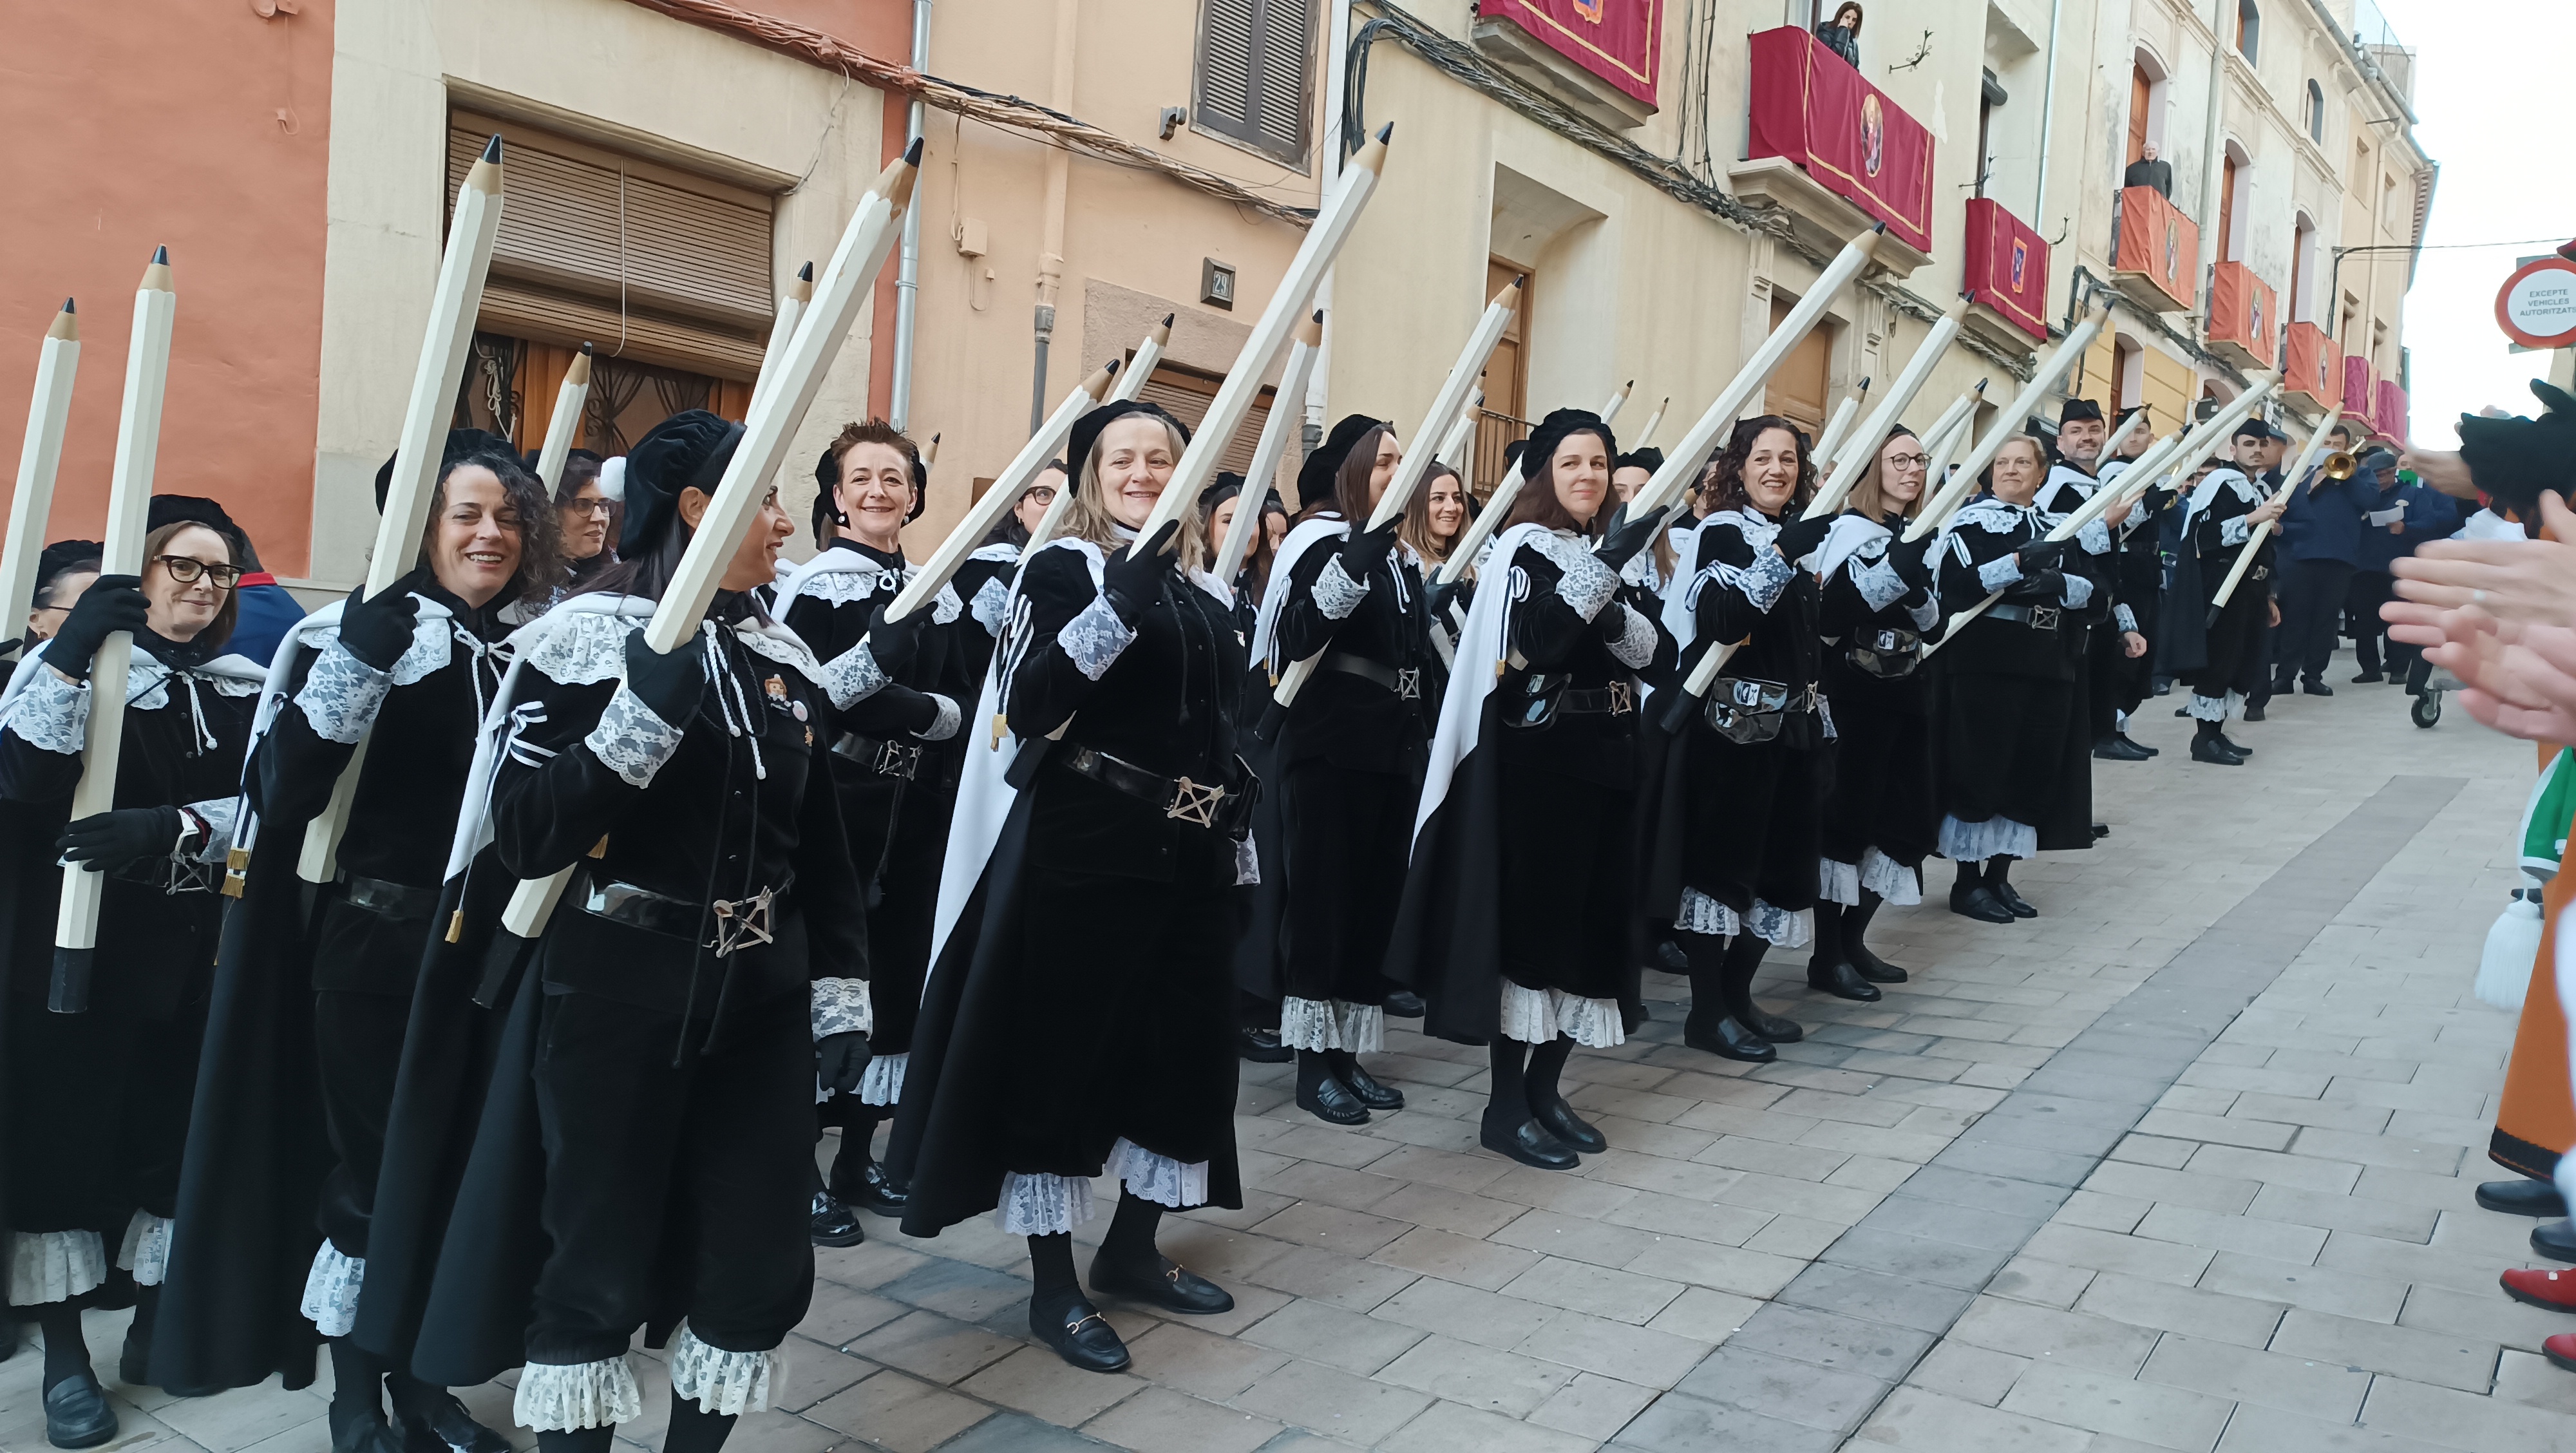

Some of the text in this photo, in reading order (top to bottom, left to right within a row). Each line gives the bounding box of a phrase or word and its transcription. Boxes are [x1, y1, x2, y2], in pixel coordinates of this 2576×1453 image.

[1215, 274, 1227, 294] 29
[2530, 289, 2568, 298] EXCEPTE
[2528, 298, 2570, 307] VEHICLES
[2520, 307, 2576, 316] AUTORITZATS
